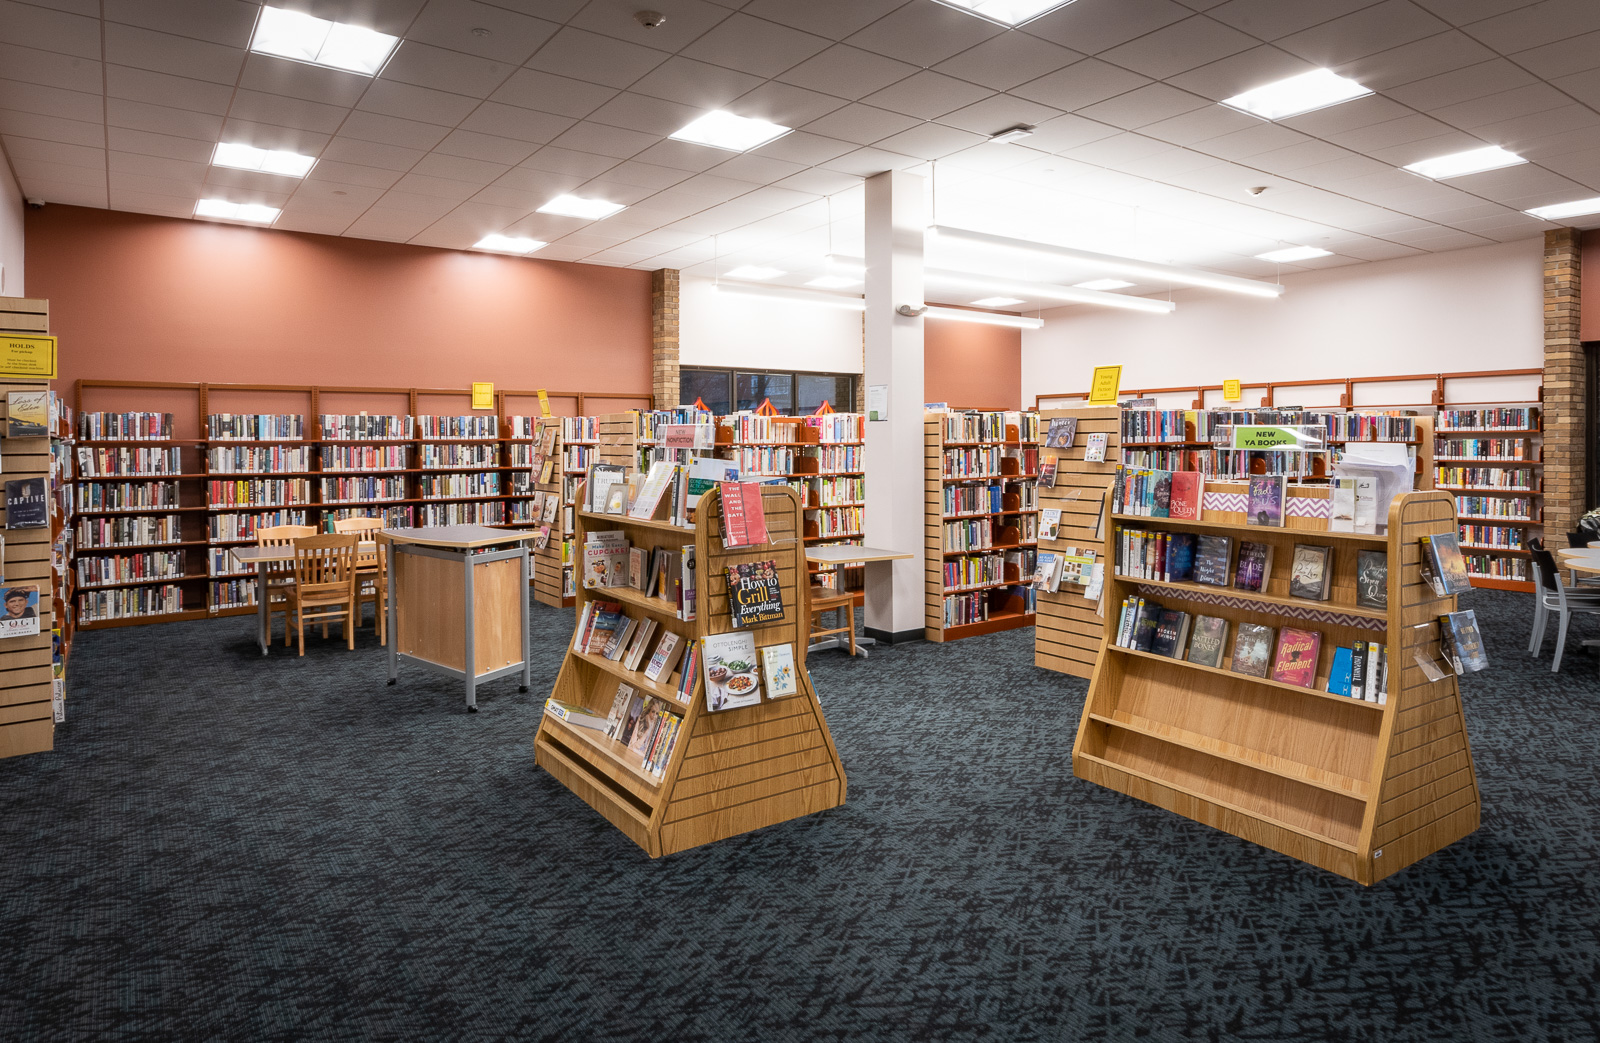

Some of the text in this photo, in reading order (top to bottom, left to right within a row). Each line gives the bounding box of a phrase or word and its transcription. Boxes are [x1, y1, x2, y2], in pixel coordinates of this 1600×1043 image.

[7, 494, 45, 505] CAPTIVE
[740, 577, 778, 590] How to
[737, 586, 769, 605] Grill
[741, 601, 781, 615] Everything
[741, 612, 783, 624] Mark Bittman
[713, 640, 748, 648] OTTOLENGHI
[1192, 633, 1220, 646] RATTLED
[1193, 641, 1216, 652] BONES
[1280, 640, 1314, 658] Radical
[1276, 658, 1313, 672] Element
